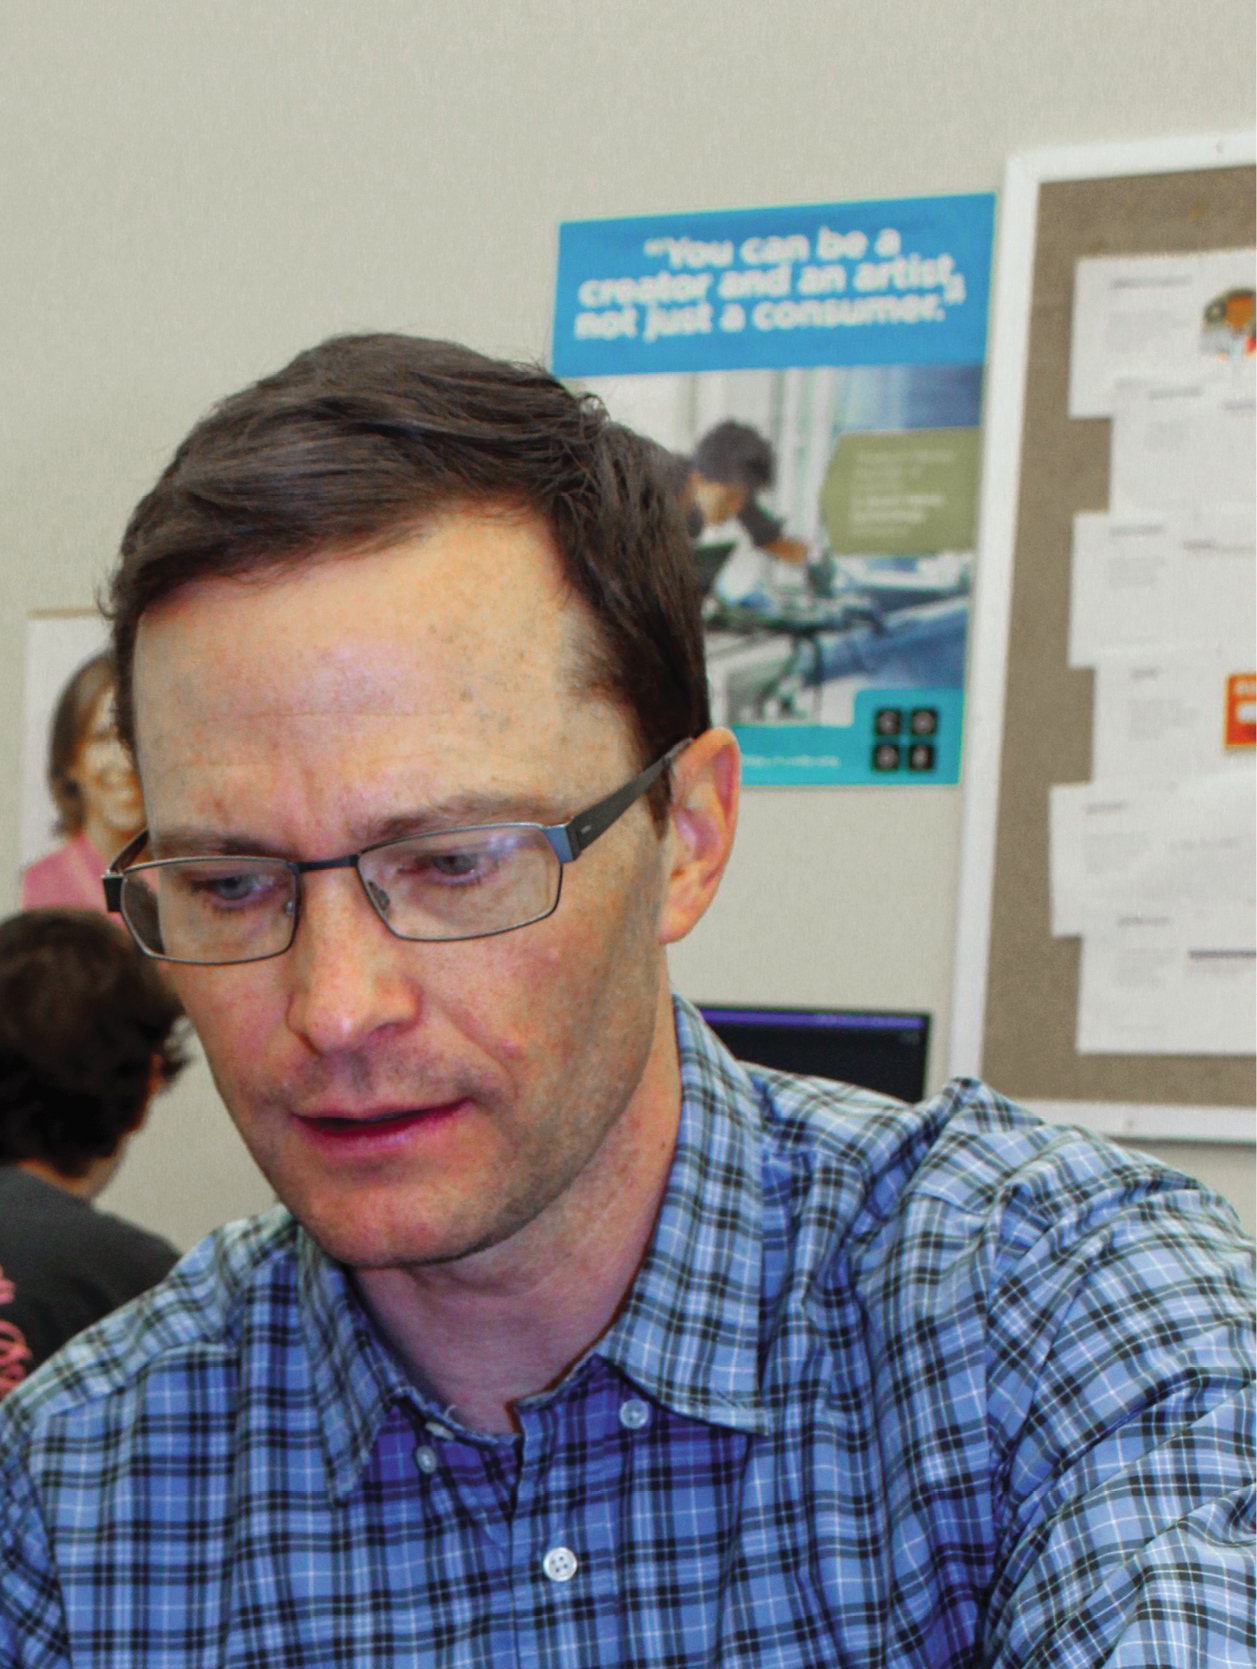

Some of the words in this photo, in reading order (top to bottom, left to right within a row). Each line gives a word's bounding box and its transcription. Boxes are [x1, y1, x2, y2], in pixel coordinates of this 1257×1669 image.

[741, 234, 810, 264] can
[817, 224, 868, 261] be
[875, 227, 901, 257] a
[578, 270, 713, 307] creator
[718, 265, 792, 300] and
[798, 264, 846, 296] an
[574, 304, 638, 341] not
[643, 300, 712, 343] just
[719, 303, 745, 333] a
